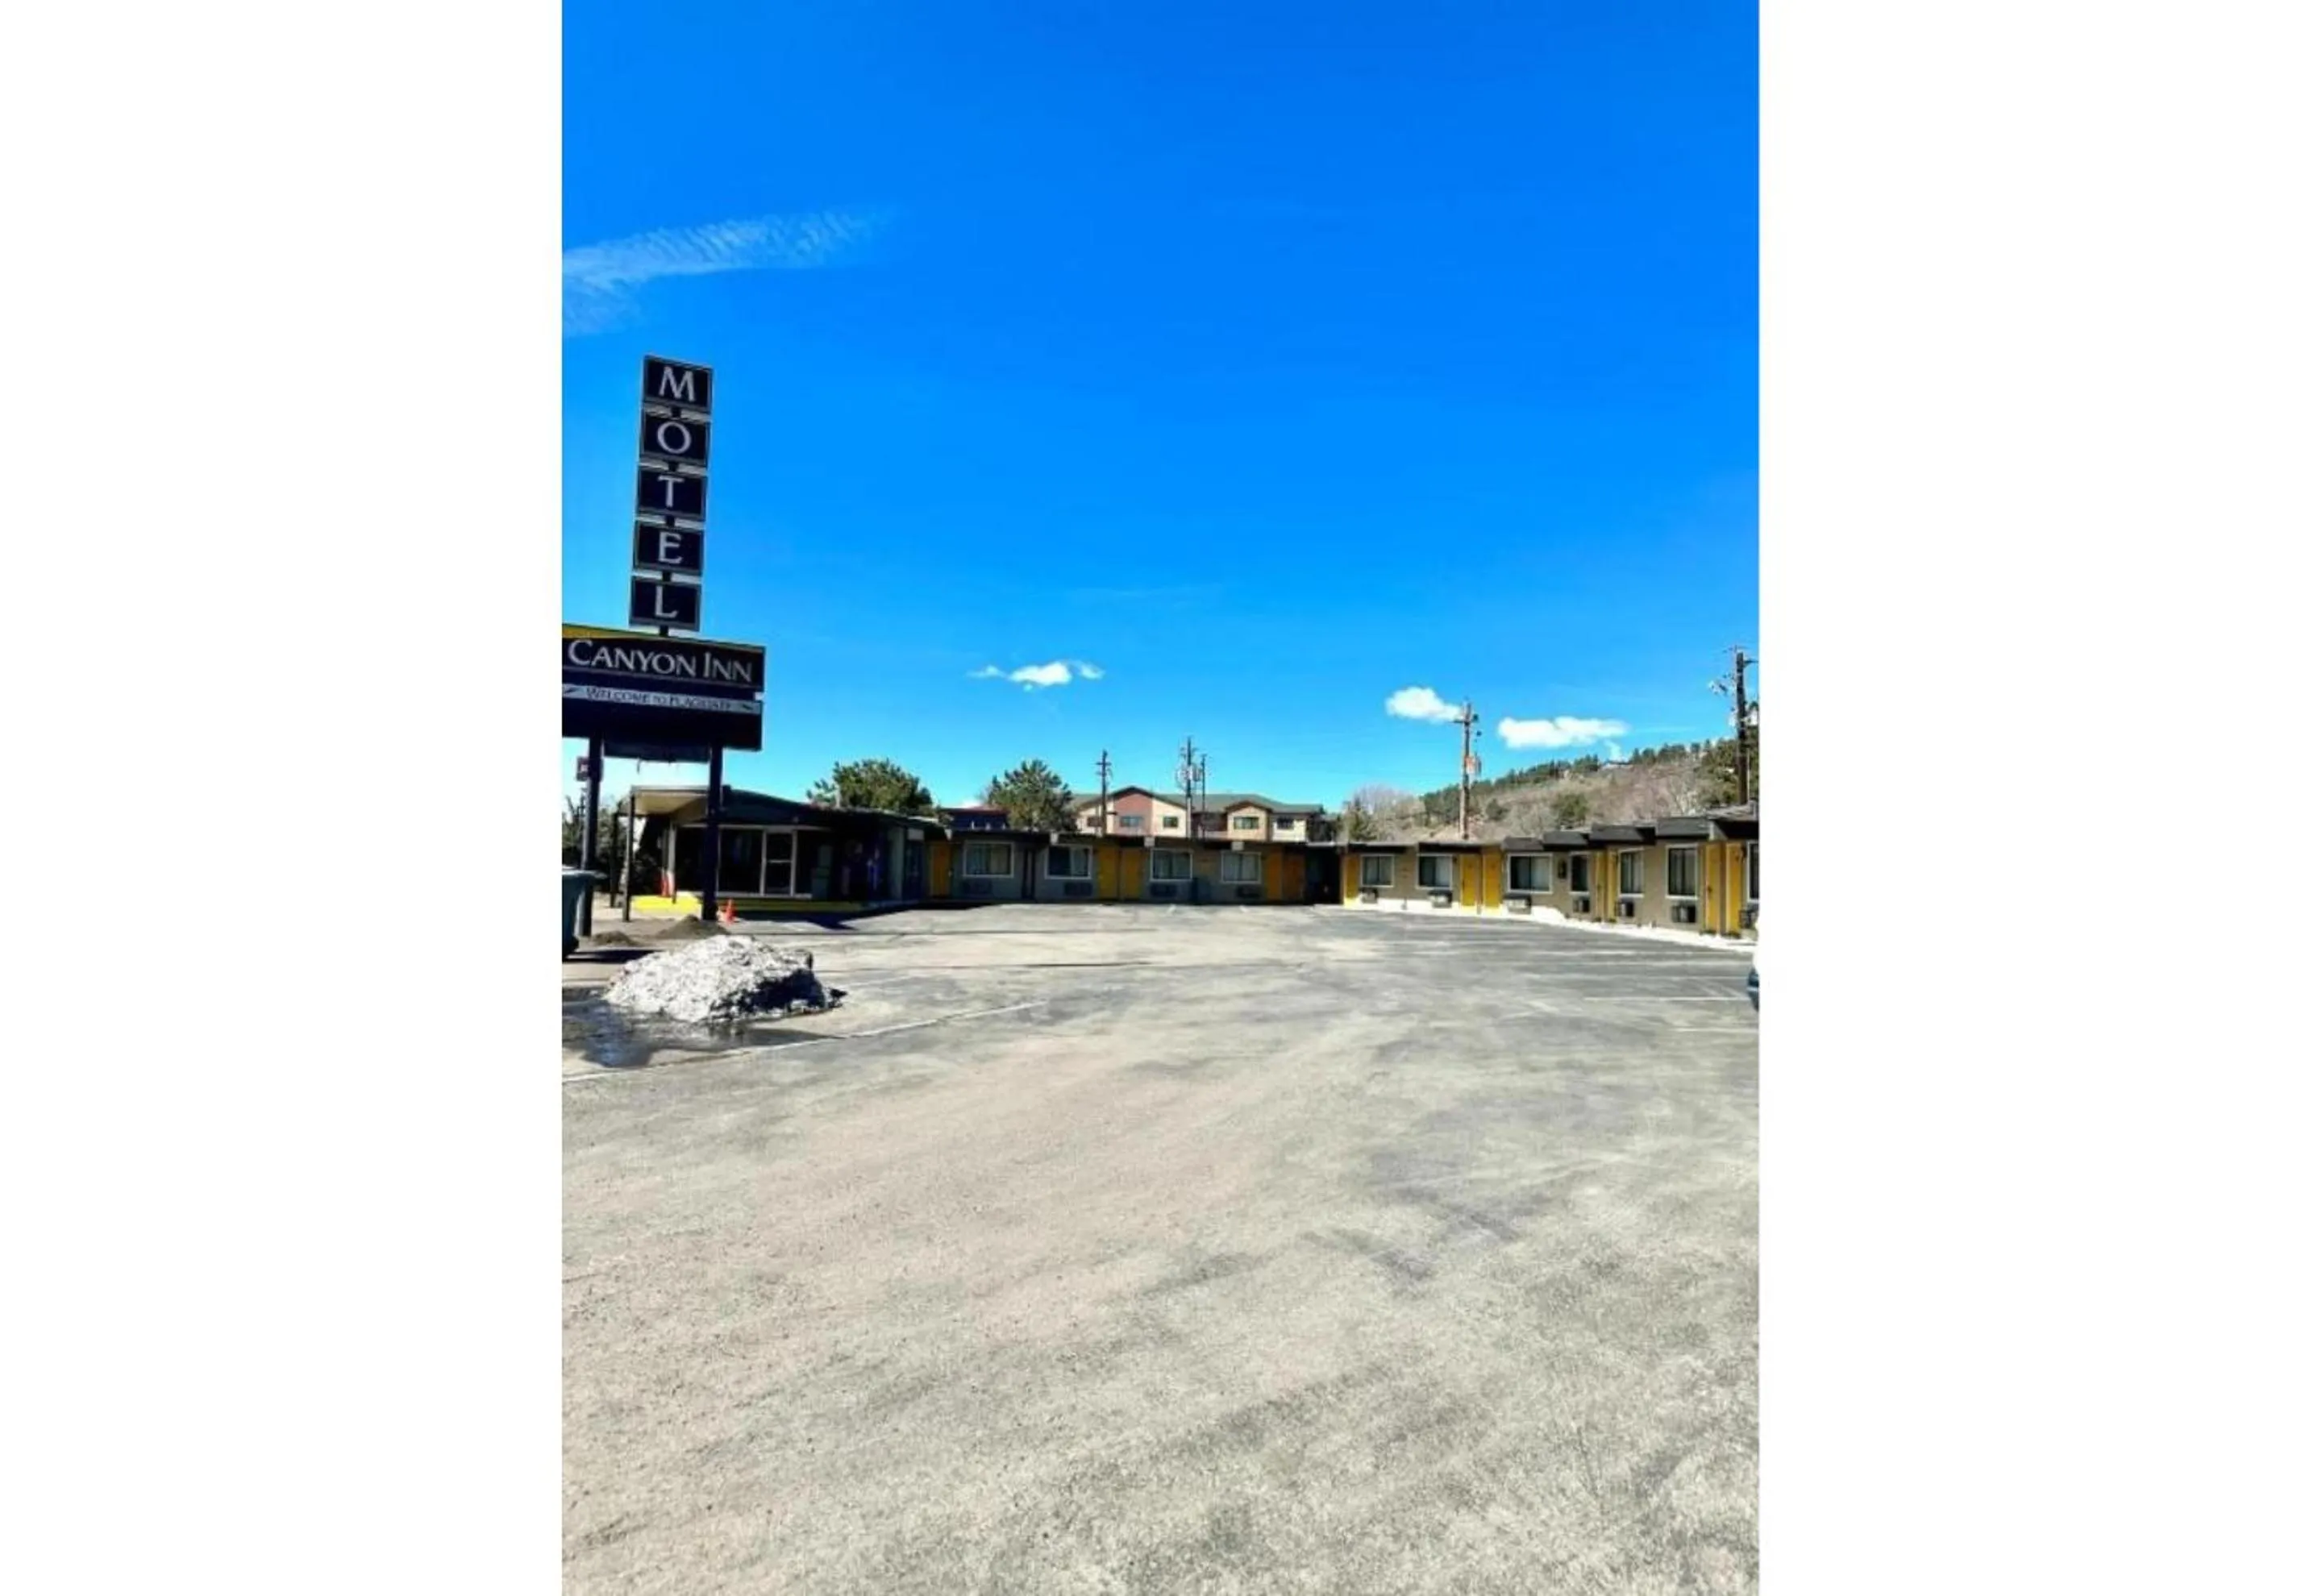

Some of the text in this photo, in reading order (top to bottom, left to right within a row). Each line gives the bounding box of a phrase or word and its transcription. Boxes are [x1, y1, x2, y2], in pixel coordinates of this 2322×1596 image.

[654, 365, 696, 619] MOTEL
[568, 639, 753, 683] CANYON INN
[586, 686, 647, 704] WELCOME
